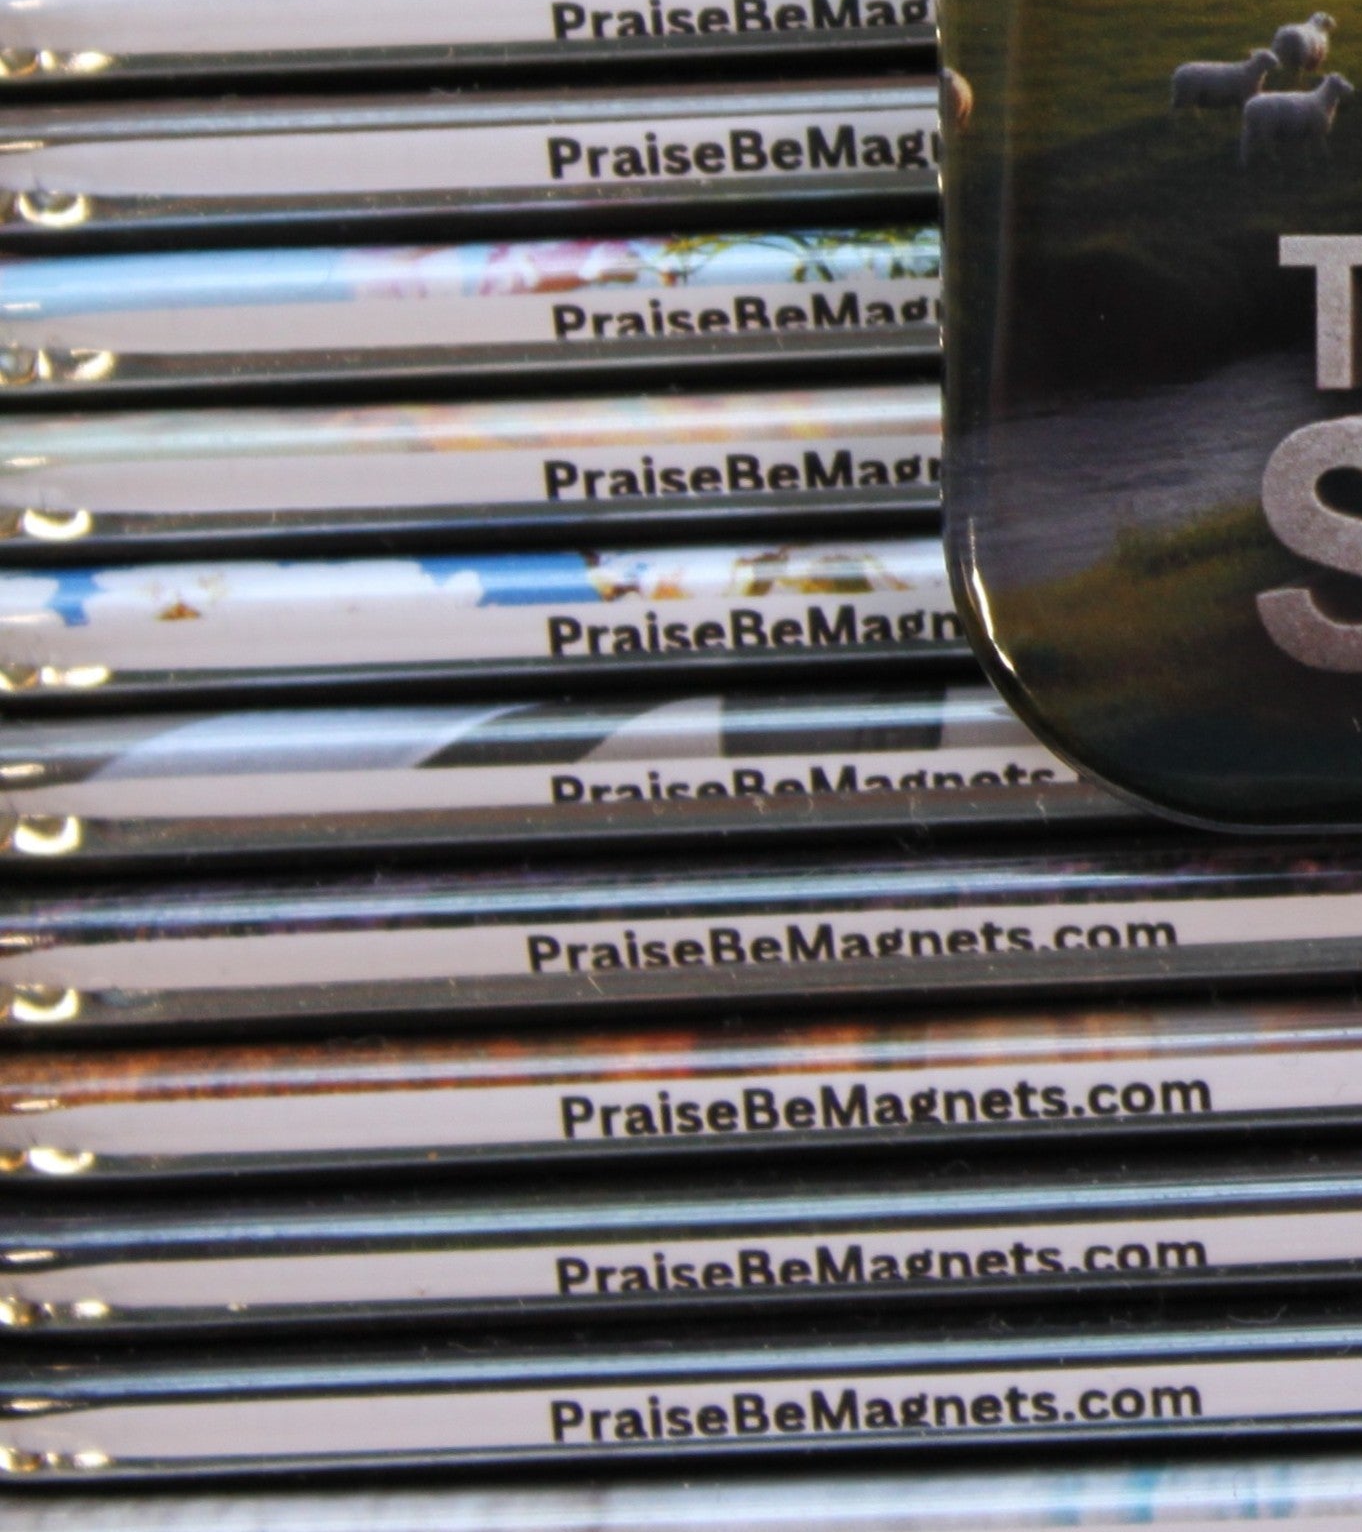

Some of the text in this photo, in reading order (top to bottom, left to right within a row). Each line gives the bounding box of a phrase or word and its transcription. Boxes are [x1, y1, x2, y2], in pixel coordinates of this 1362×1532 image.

[547, 125, 939, 178] PraiseBeMag
[552, 293, 942, 340] PraiseBeMag
[543, 451, 942, 500] PraiseBeMag
[549, 606, 965, 655] PraiseBeMagn
[527, 920, 1177, 973] PraiseBeMagnets.com
[560, 1079, 1212, 1138] PraiseBeMagnets.com
[556, 1239, 1207, 1294] PraiseBeMagnets.com
[551, 1382, 1201, 1443] PraiseBeMagnets.com
